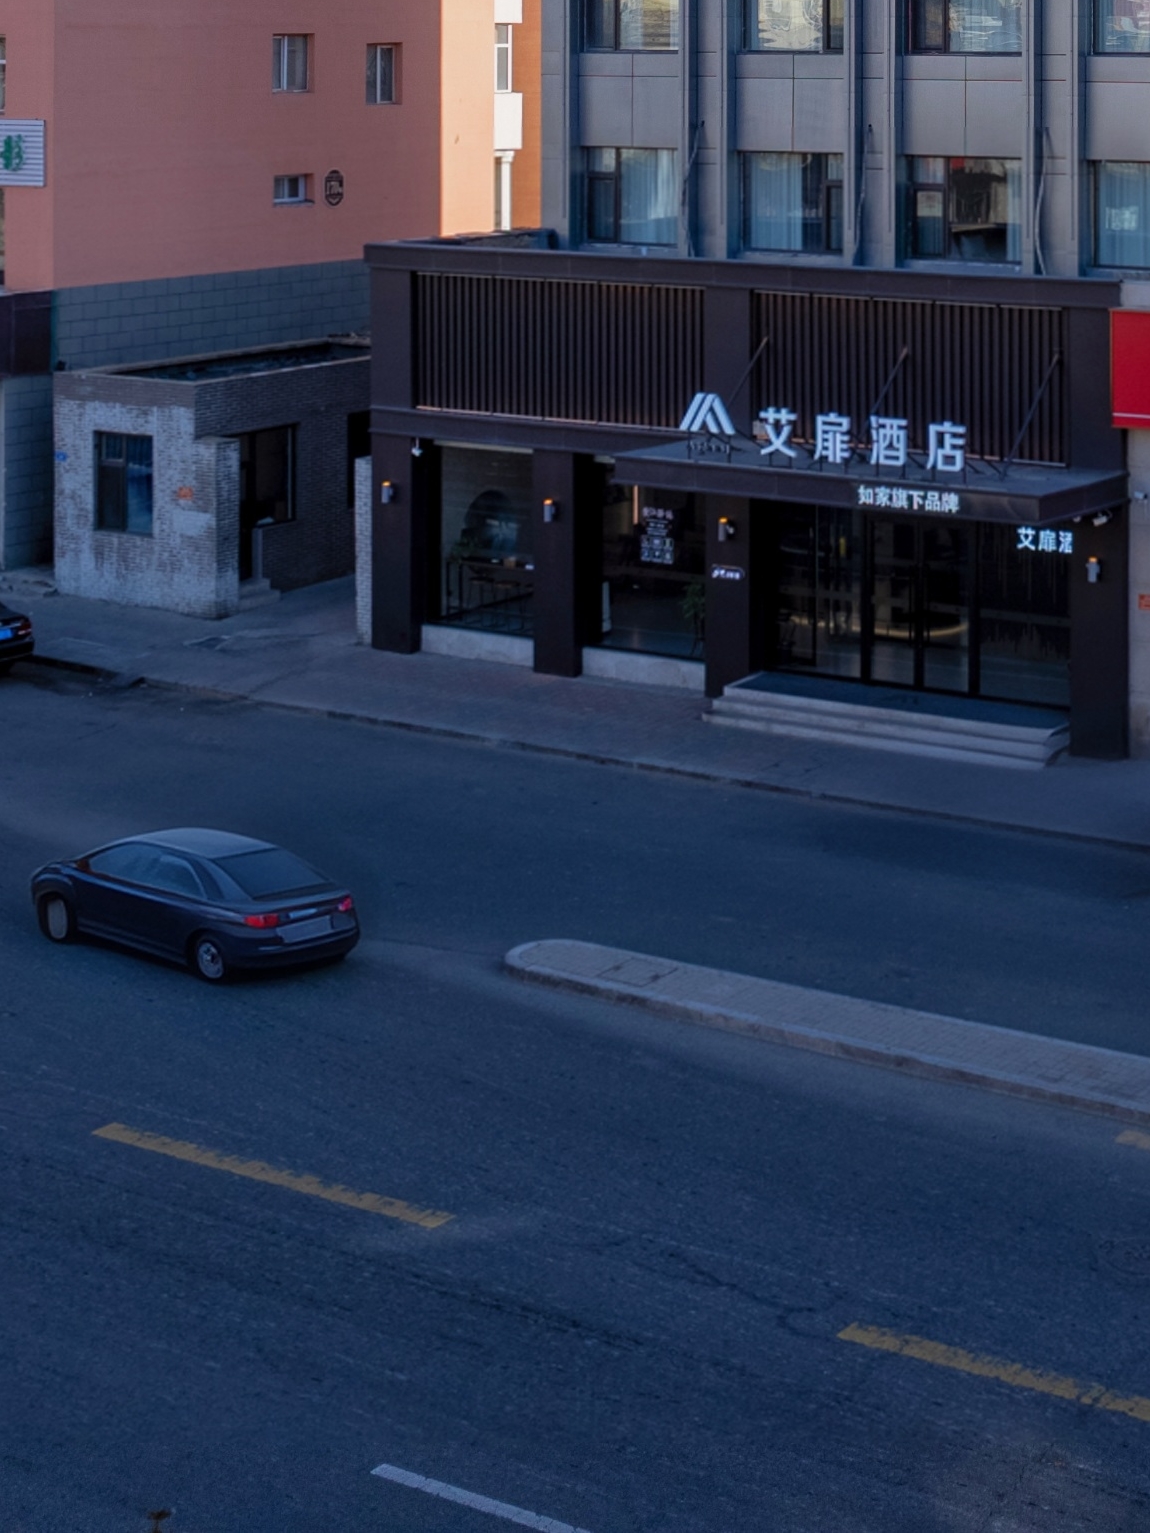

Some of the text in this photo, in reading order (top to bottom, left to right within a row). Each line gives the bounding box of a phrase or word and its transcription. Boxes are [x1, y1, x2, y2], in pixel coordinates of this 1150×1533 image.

[759, 408, 967, 472] 艾扉酒店
[857, 484, 960, 513] 如家旗下品牌
